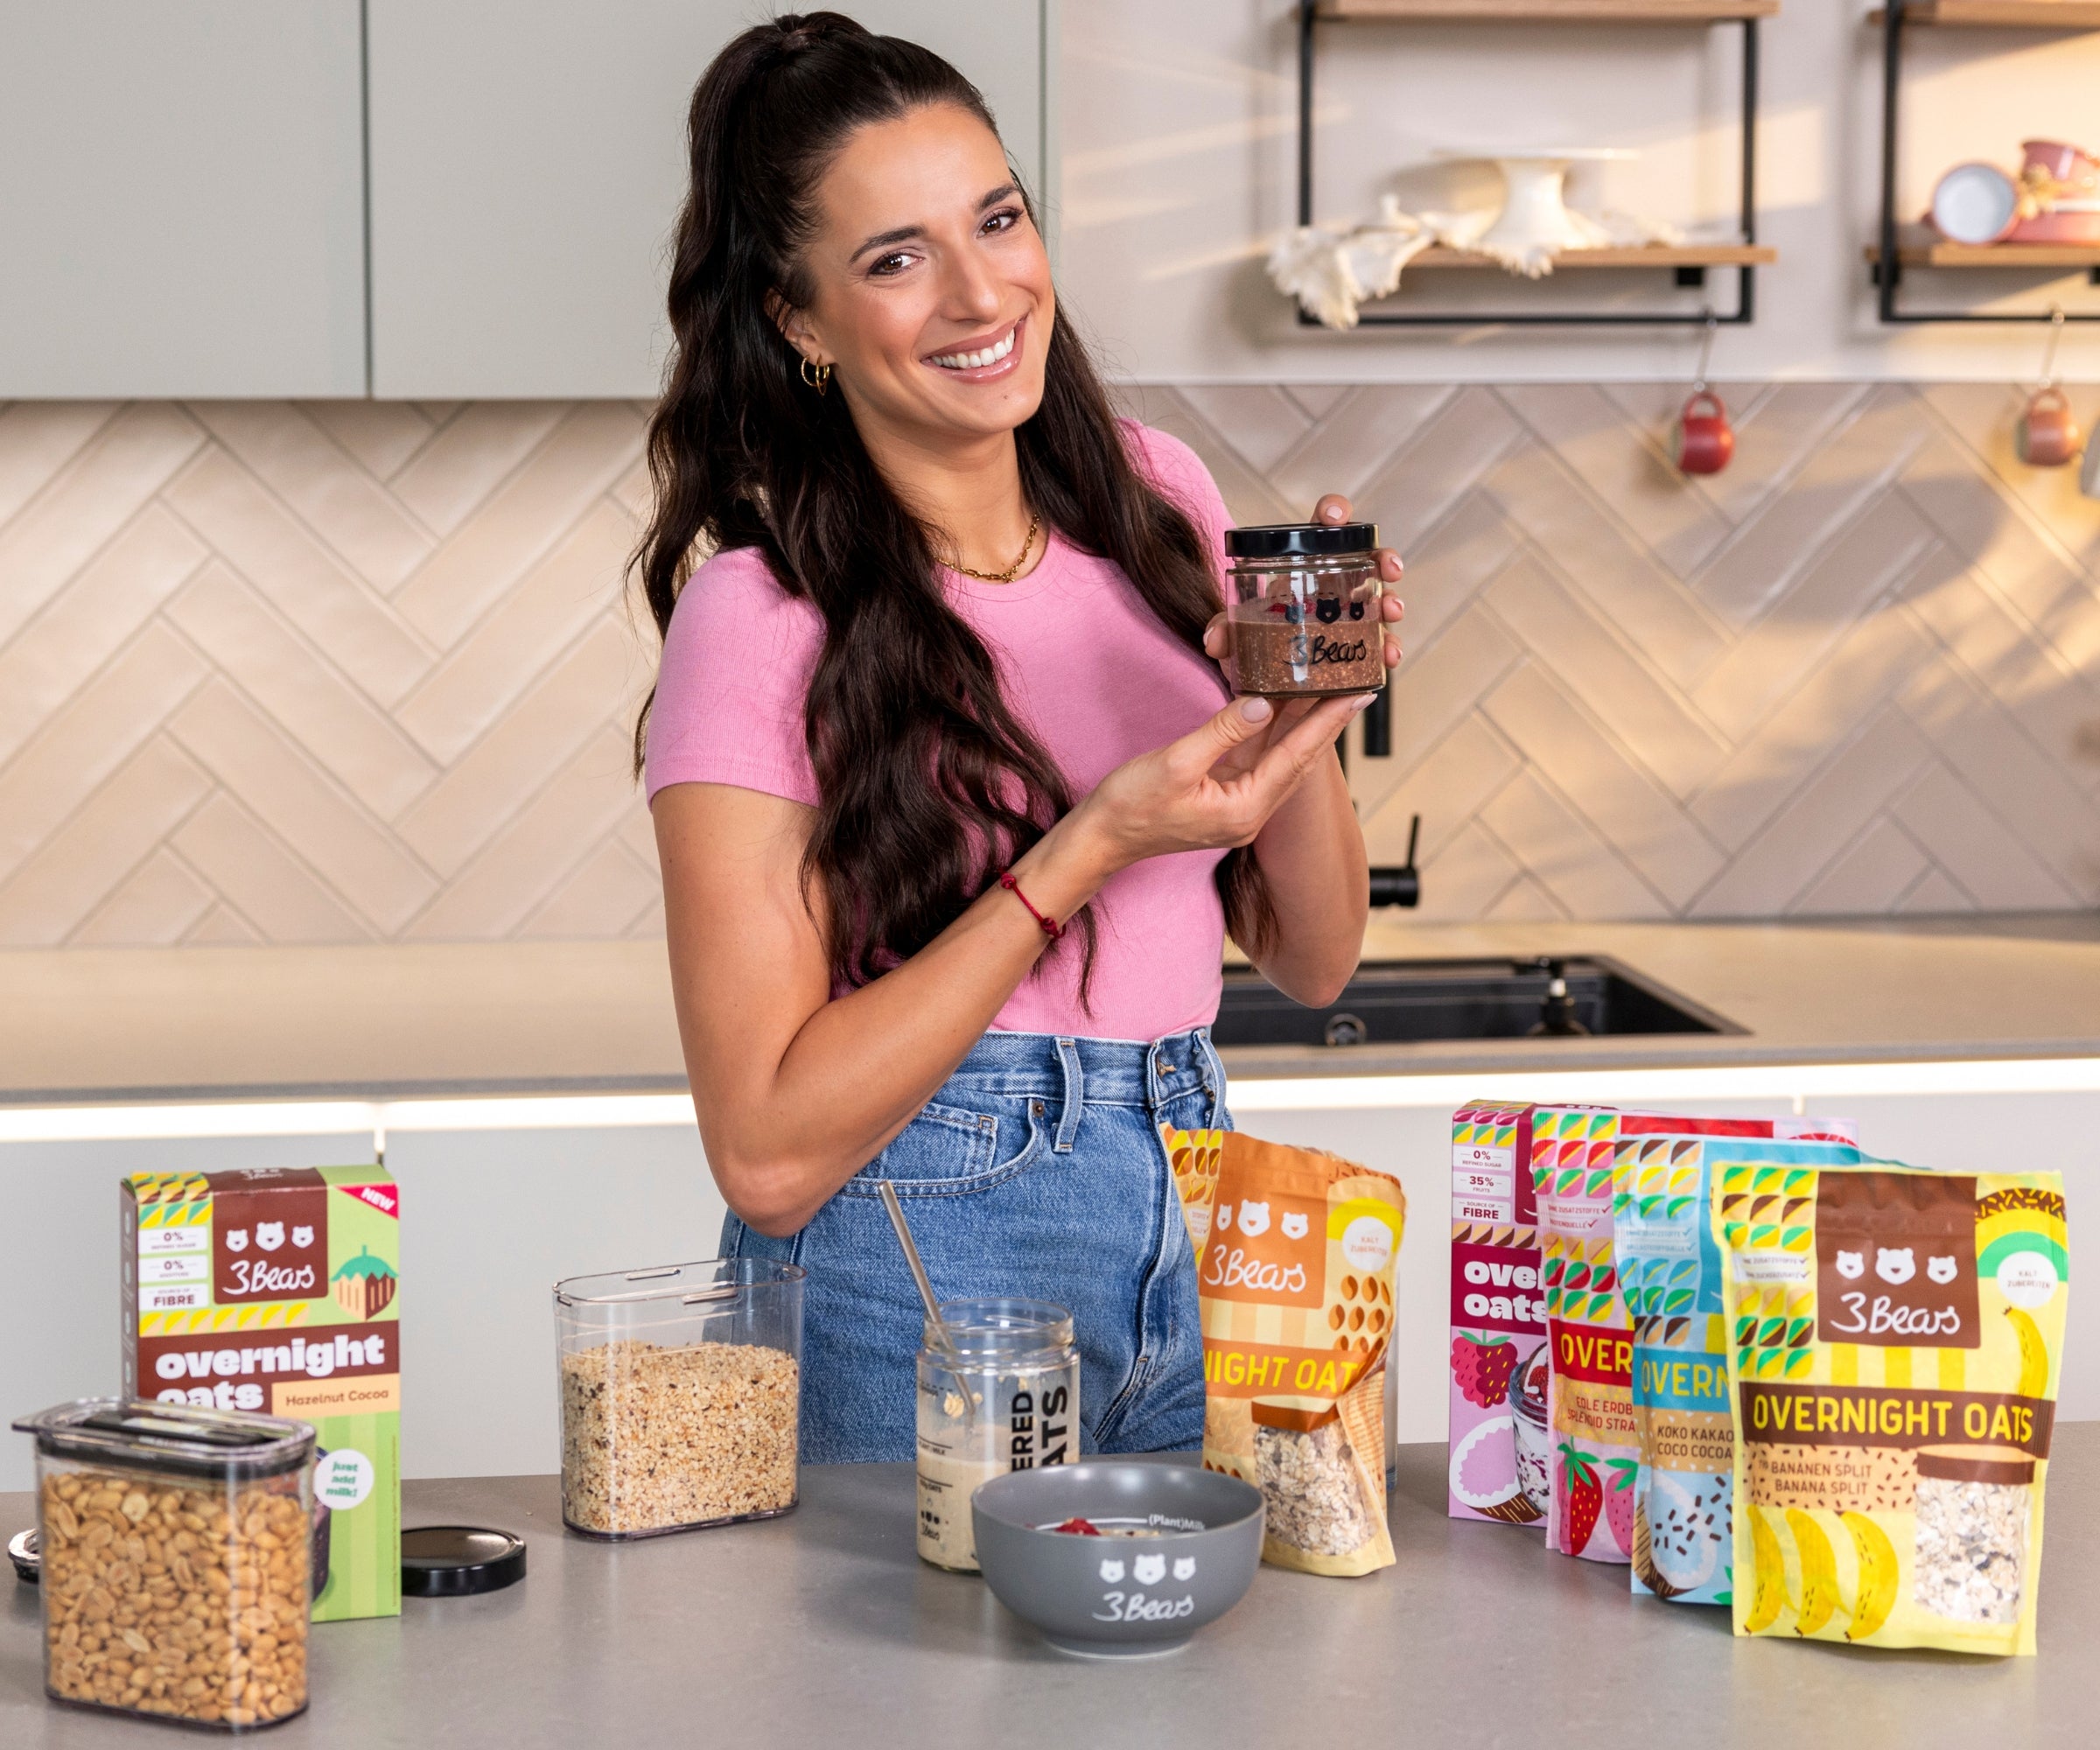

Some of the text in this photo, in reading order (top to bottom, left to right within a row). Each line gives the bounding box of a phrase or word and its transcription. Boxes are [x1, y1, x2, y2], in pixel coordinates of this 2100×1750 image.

[1474, 1150, 1491, 1160] 0%
[1469, 1176, 1494, 1186] 35%
[360, 1186, 396, 1211] NEW
[1463, 1208, 1499, 1220] FIBRE
[222, 1260, 315, 1295] 3Bears
[1203, 1244, 1306, 1292] 3Bears
[154, 1295, 194, 1306] FIBRE
[1464, 1293, 1546, 1324] oats
[1830, 1292, 1961, 1336] 3Bears
[155, 1334, 385, 1376] overnight
[1561, 1333, 1633, 1374] OVER
[157, 1381, 263, 1410] oats
[286, 1390, 388, 1407] Hazelnut Cocoa
[1576, 1396, 1633, 1415] EDLE ERDB
[1606, 1418, 1635, 1432] STRA
[1753, 1394, 2034, 1443] OVERNIGHT OATS
[1657, 1425, 1734, 1443] KOKO KAKAO
[1657, 1442, 1732, 1460] COCO COCOA
[1771, 1460, 1831, 1477] BANANEN
[1835, 1464, 1872, 1478] SPLIT
[1774, 1479, 1867, 1494] BANANA SPLIT
[1092, 1591, 1194, 1621] 3Bears
